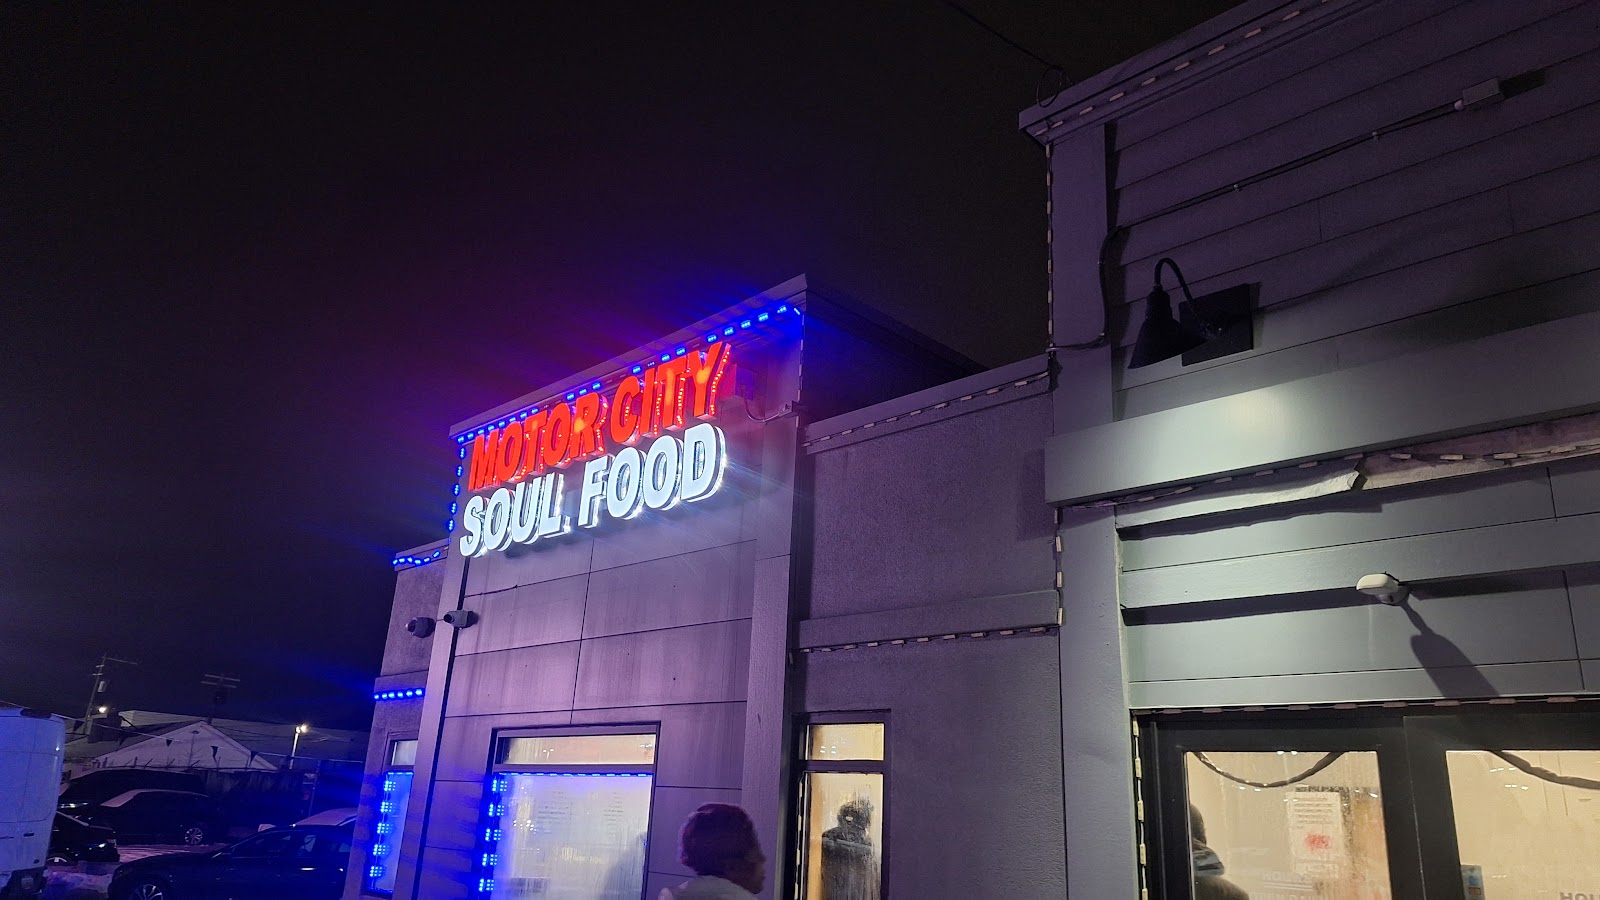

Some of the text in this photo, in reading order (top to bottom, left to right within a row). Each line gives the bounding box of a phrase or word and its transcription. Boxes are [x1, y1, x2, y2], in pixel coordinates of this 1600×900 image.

[468, 341, 730, 491] MOTOR CITY
[459, 422, 727, 557] SOUL FOOD
